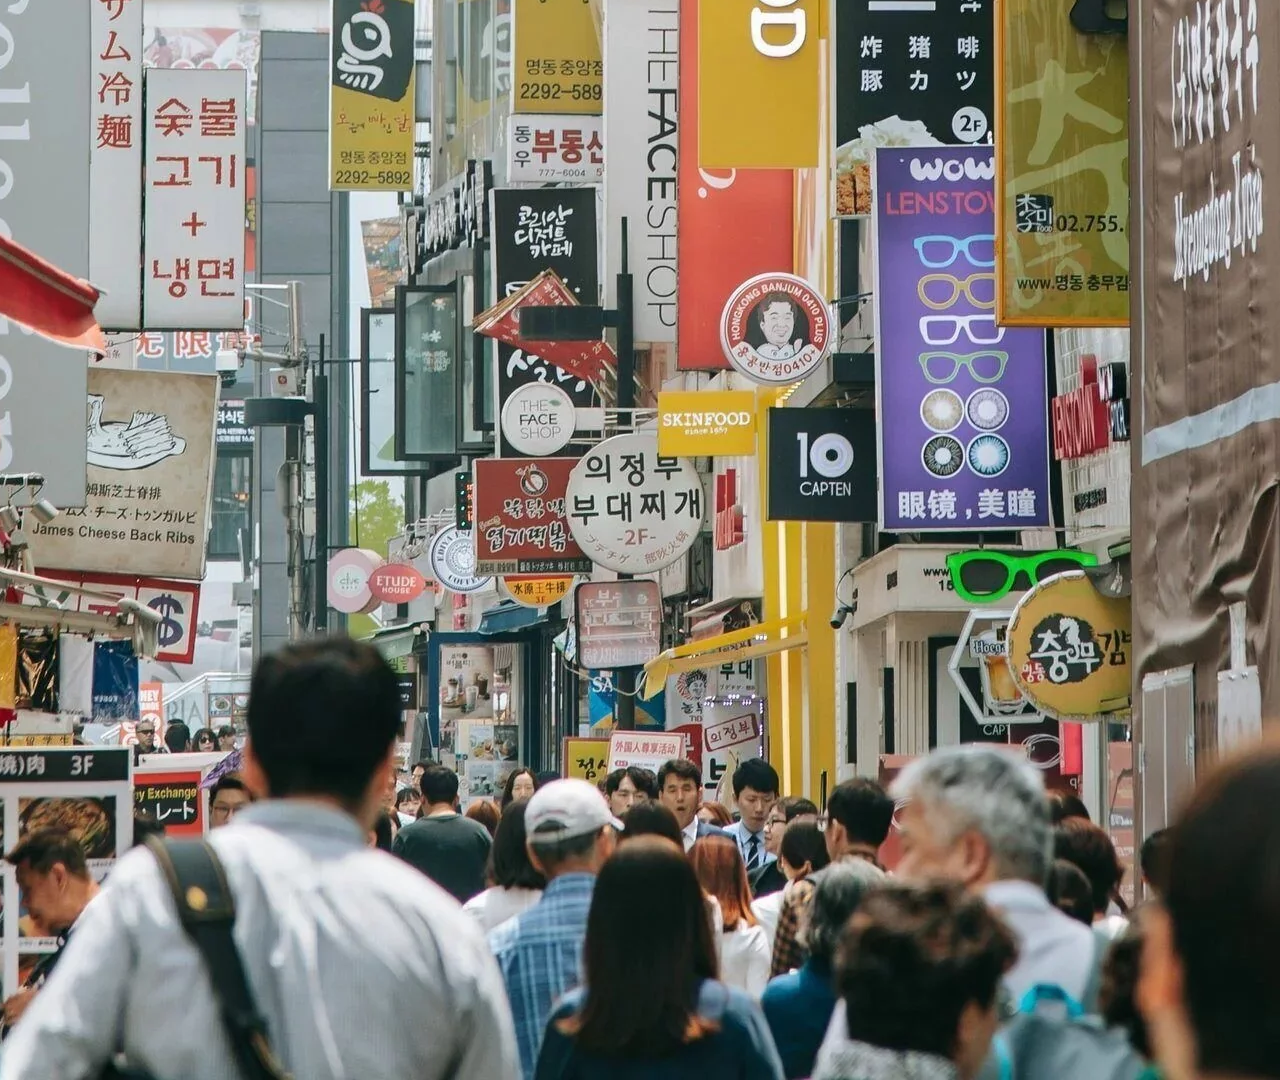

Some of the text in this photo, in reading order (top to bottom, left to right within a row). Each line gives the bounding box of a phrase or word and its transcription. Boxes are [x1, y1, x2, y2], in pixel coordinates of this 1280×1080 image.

[860, 70, 977, 92] 豚カツ
[520, 82, 603, 101] 2292-589
[154, 97, 238, 137] 숯불
[960, 115, 982, 132] 2F
[514, 125, 532, 168] 동우
[153, 154, 237, 188] 고기
[335, 170, 411, 186] 2292-5892
[518, 204, 574, 226] 코리안
[514, 225, 568, 245] 디저트
[529, 241, 574, 259] 카페
[153, 258, 236, 299] 냉면
[731, 283, 825, 344] HONGKONG BANJUM 0410 PLUS
[521, 400, 549, 412] THE
[520, 413, 558, 425] FACE
[662, 411, 751, 427] SKINFOOD
[520, 426, 562, 440] SHOP
[585, 452, 682, 487] 의정부
[799, 481, 852, 498] CAPTEN
[571, 487, 701, 527] 부대찌개
[32, 522, 196, 546] James Cheese Back Ribs
[486, 520, 574, 554] 엽기떡볶
[376, 574, 417, 588] ETUDE
[381, 587, 411, 595] HOUSE
[711, 721, 751, 744] 의정부
[614, 739, 677, 755] 外国人尊享活动
[70, 755, 95, 777] 3F
[146, 786, 198, 801] Exchange
